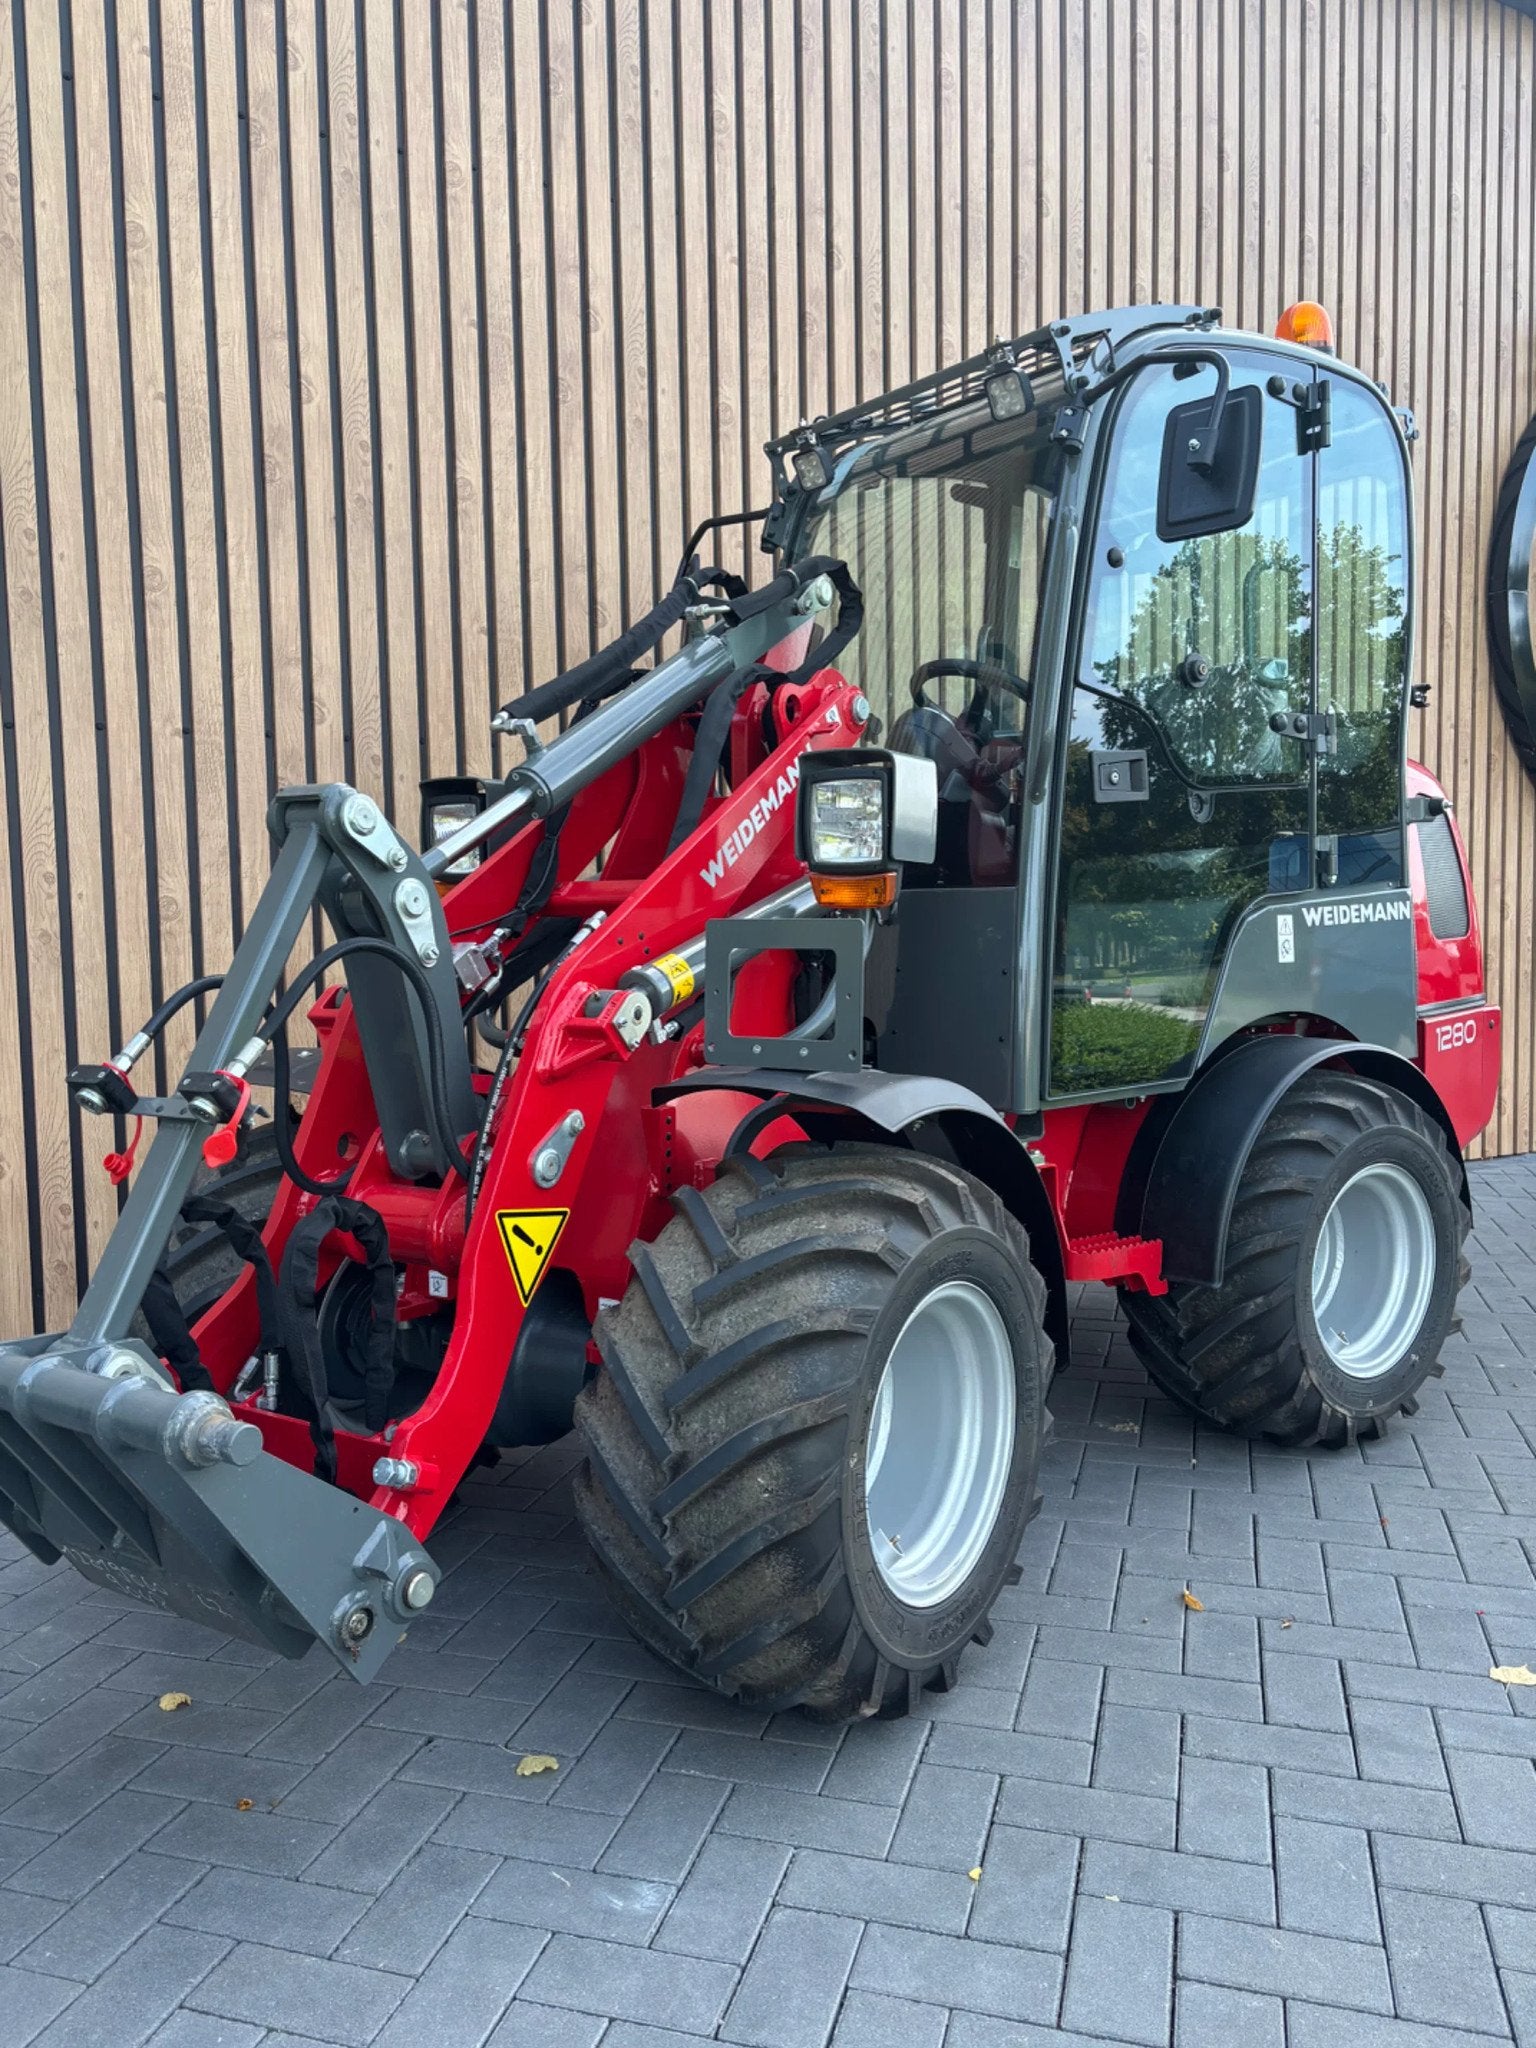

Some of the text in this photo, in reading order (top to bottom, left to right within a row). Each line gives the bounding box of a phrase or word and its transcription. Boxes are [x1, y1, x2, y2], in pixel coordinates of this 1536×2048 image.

[699, 742, 812, 888] WEIDEMAN
[1301, 901, 1411, 928] WEIDEMANN
[1436, 1019, 1477, 1053] 1280
